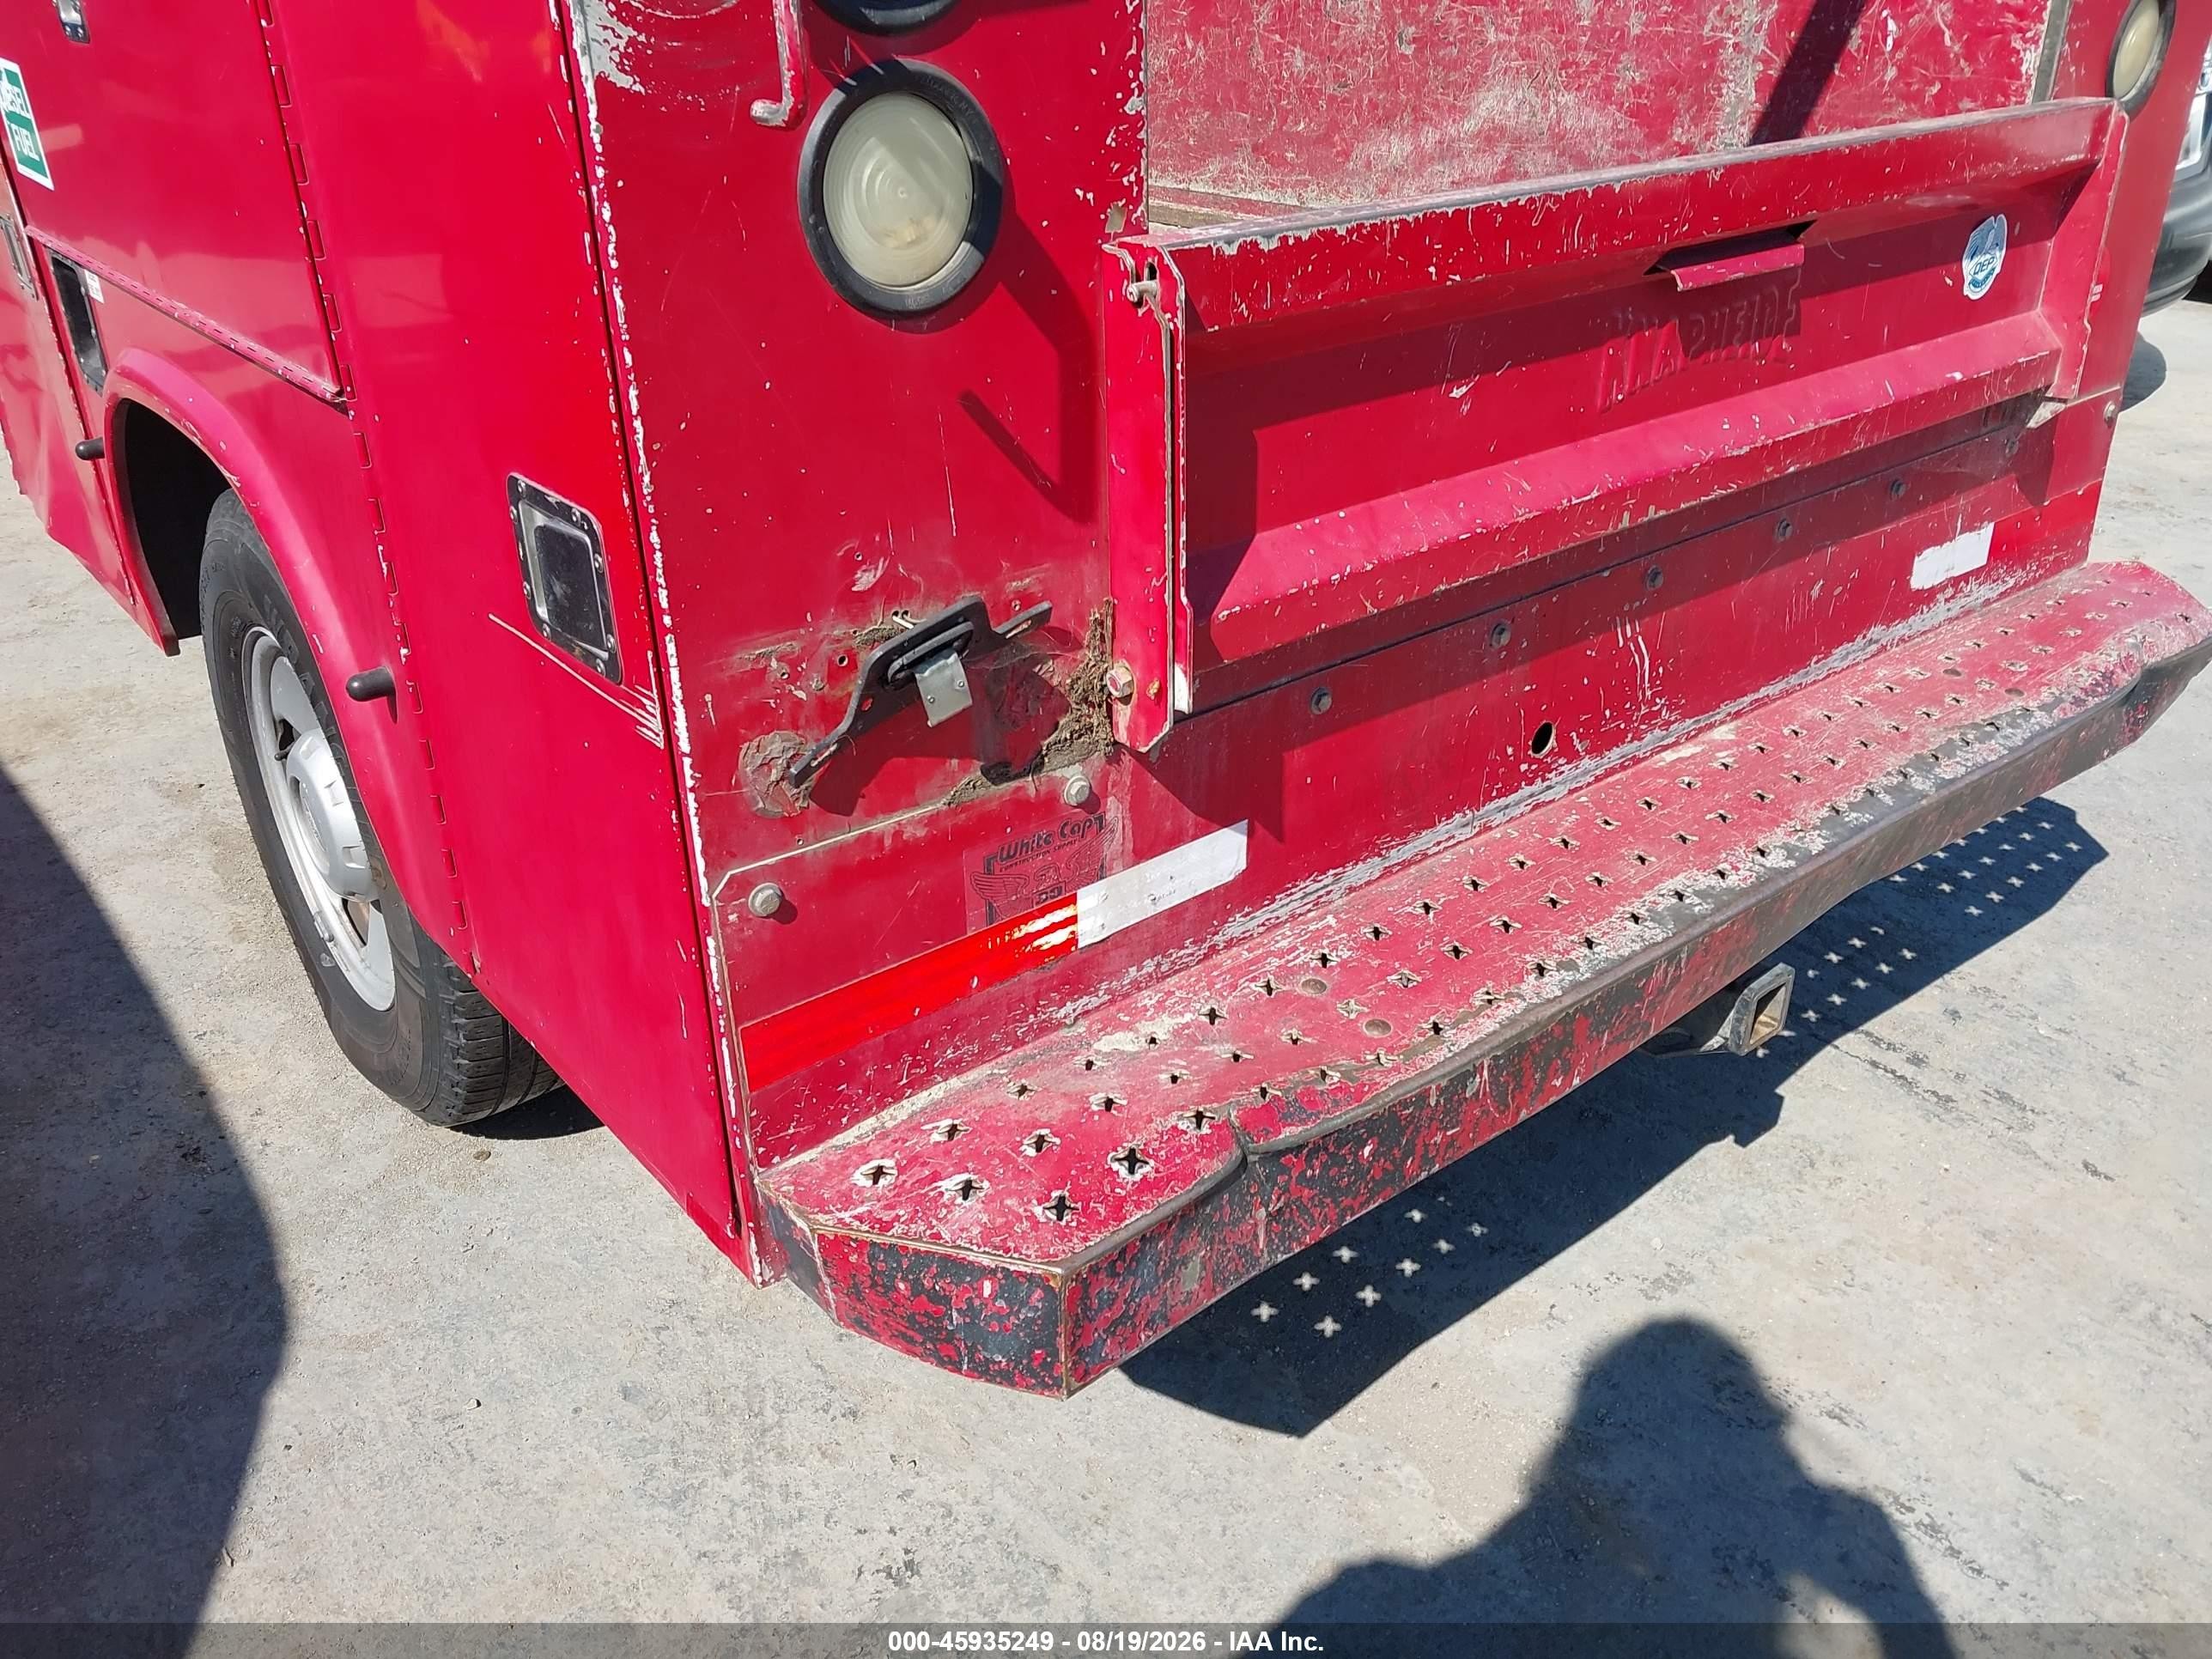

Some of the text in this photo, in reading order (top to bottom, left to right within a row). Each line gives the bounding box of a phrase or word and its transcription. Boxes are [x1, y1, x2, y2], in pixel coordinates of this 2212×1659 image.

[9, 122, 40, 161] FUEL
[999, 817, 1093, 861] White Cap
